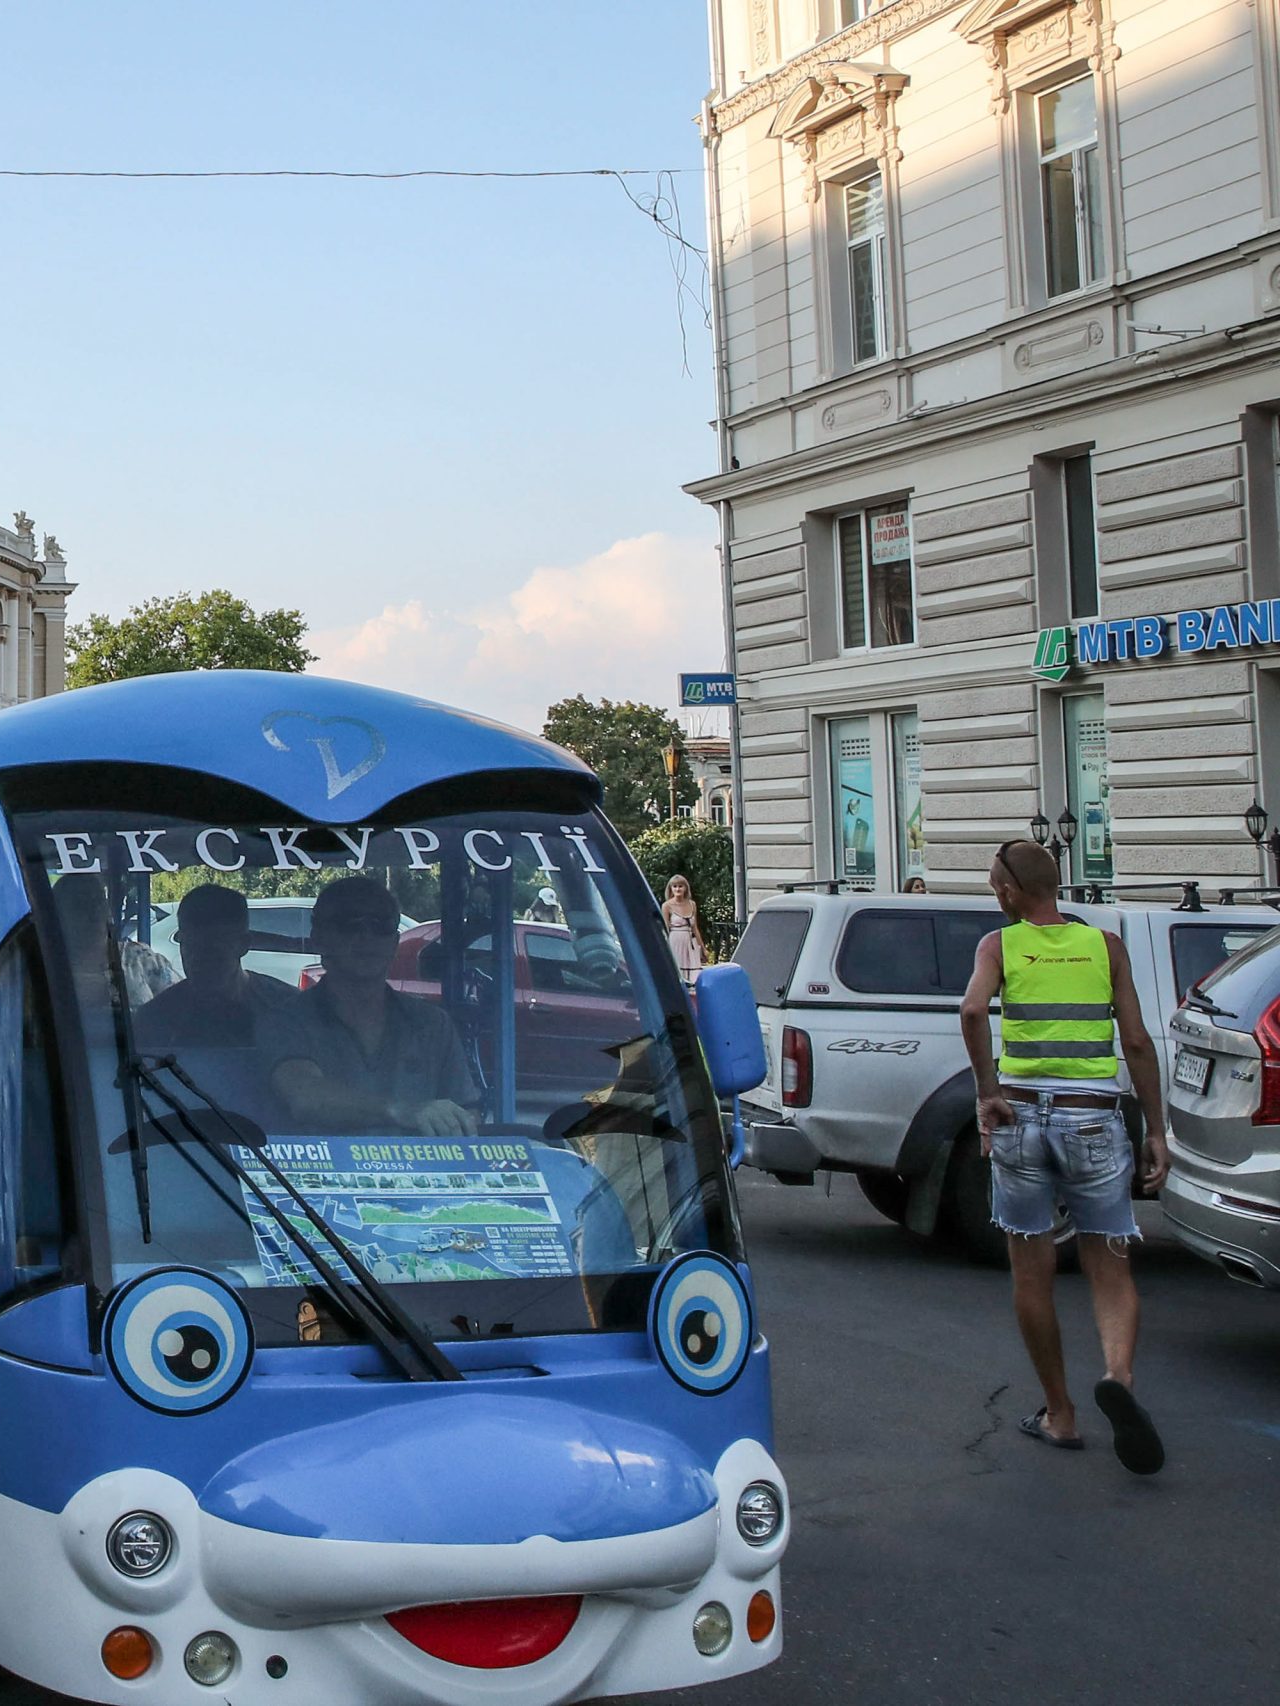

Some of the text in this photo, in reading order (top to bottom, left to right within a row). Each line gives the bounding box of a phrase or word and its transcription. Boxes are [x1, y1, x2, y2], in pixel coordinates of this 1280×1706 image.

[1078, 616, 1162, 664] MTB
[706, 682, 733, 692] MTB
[45, 825, 606, 874] ЕКСКУРСІЇ
[827, 1039, 920, 1055] 4x4
[350, 1144, 528, 1161] SIGHTSEEING TOURS
